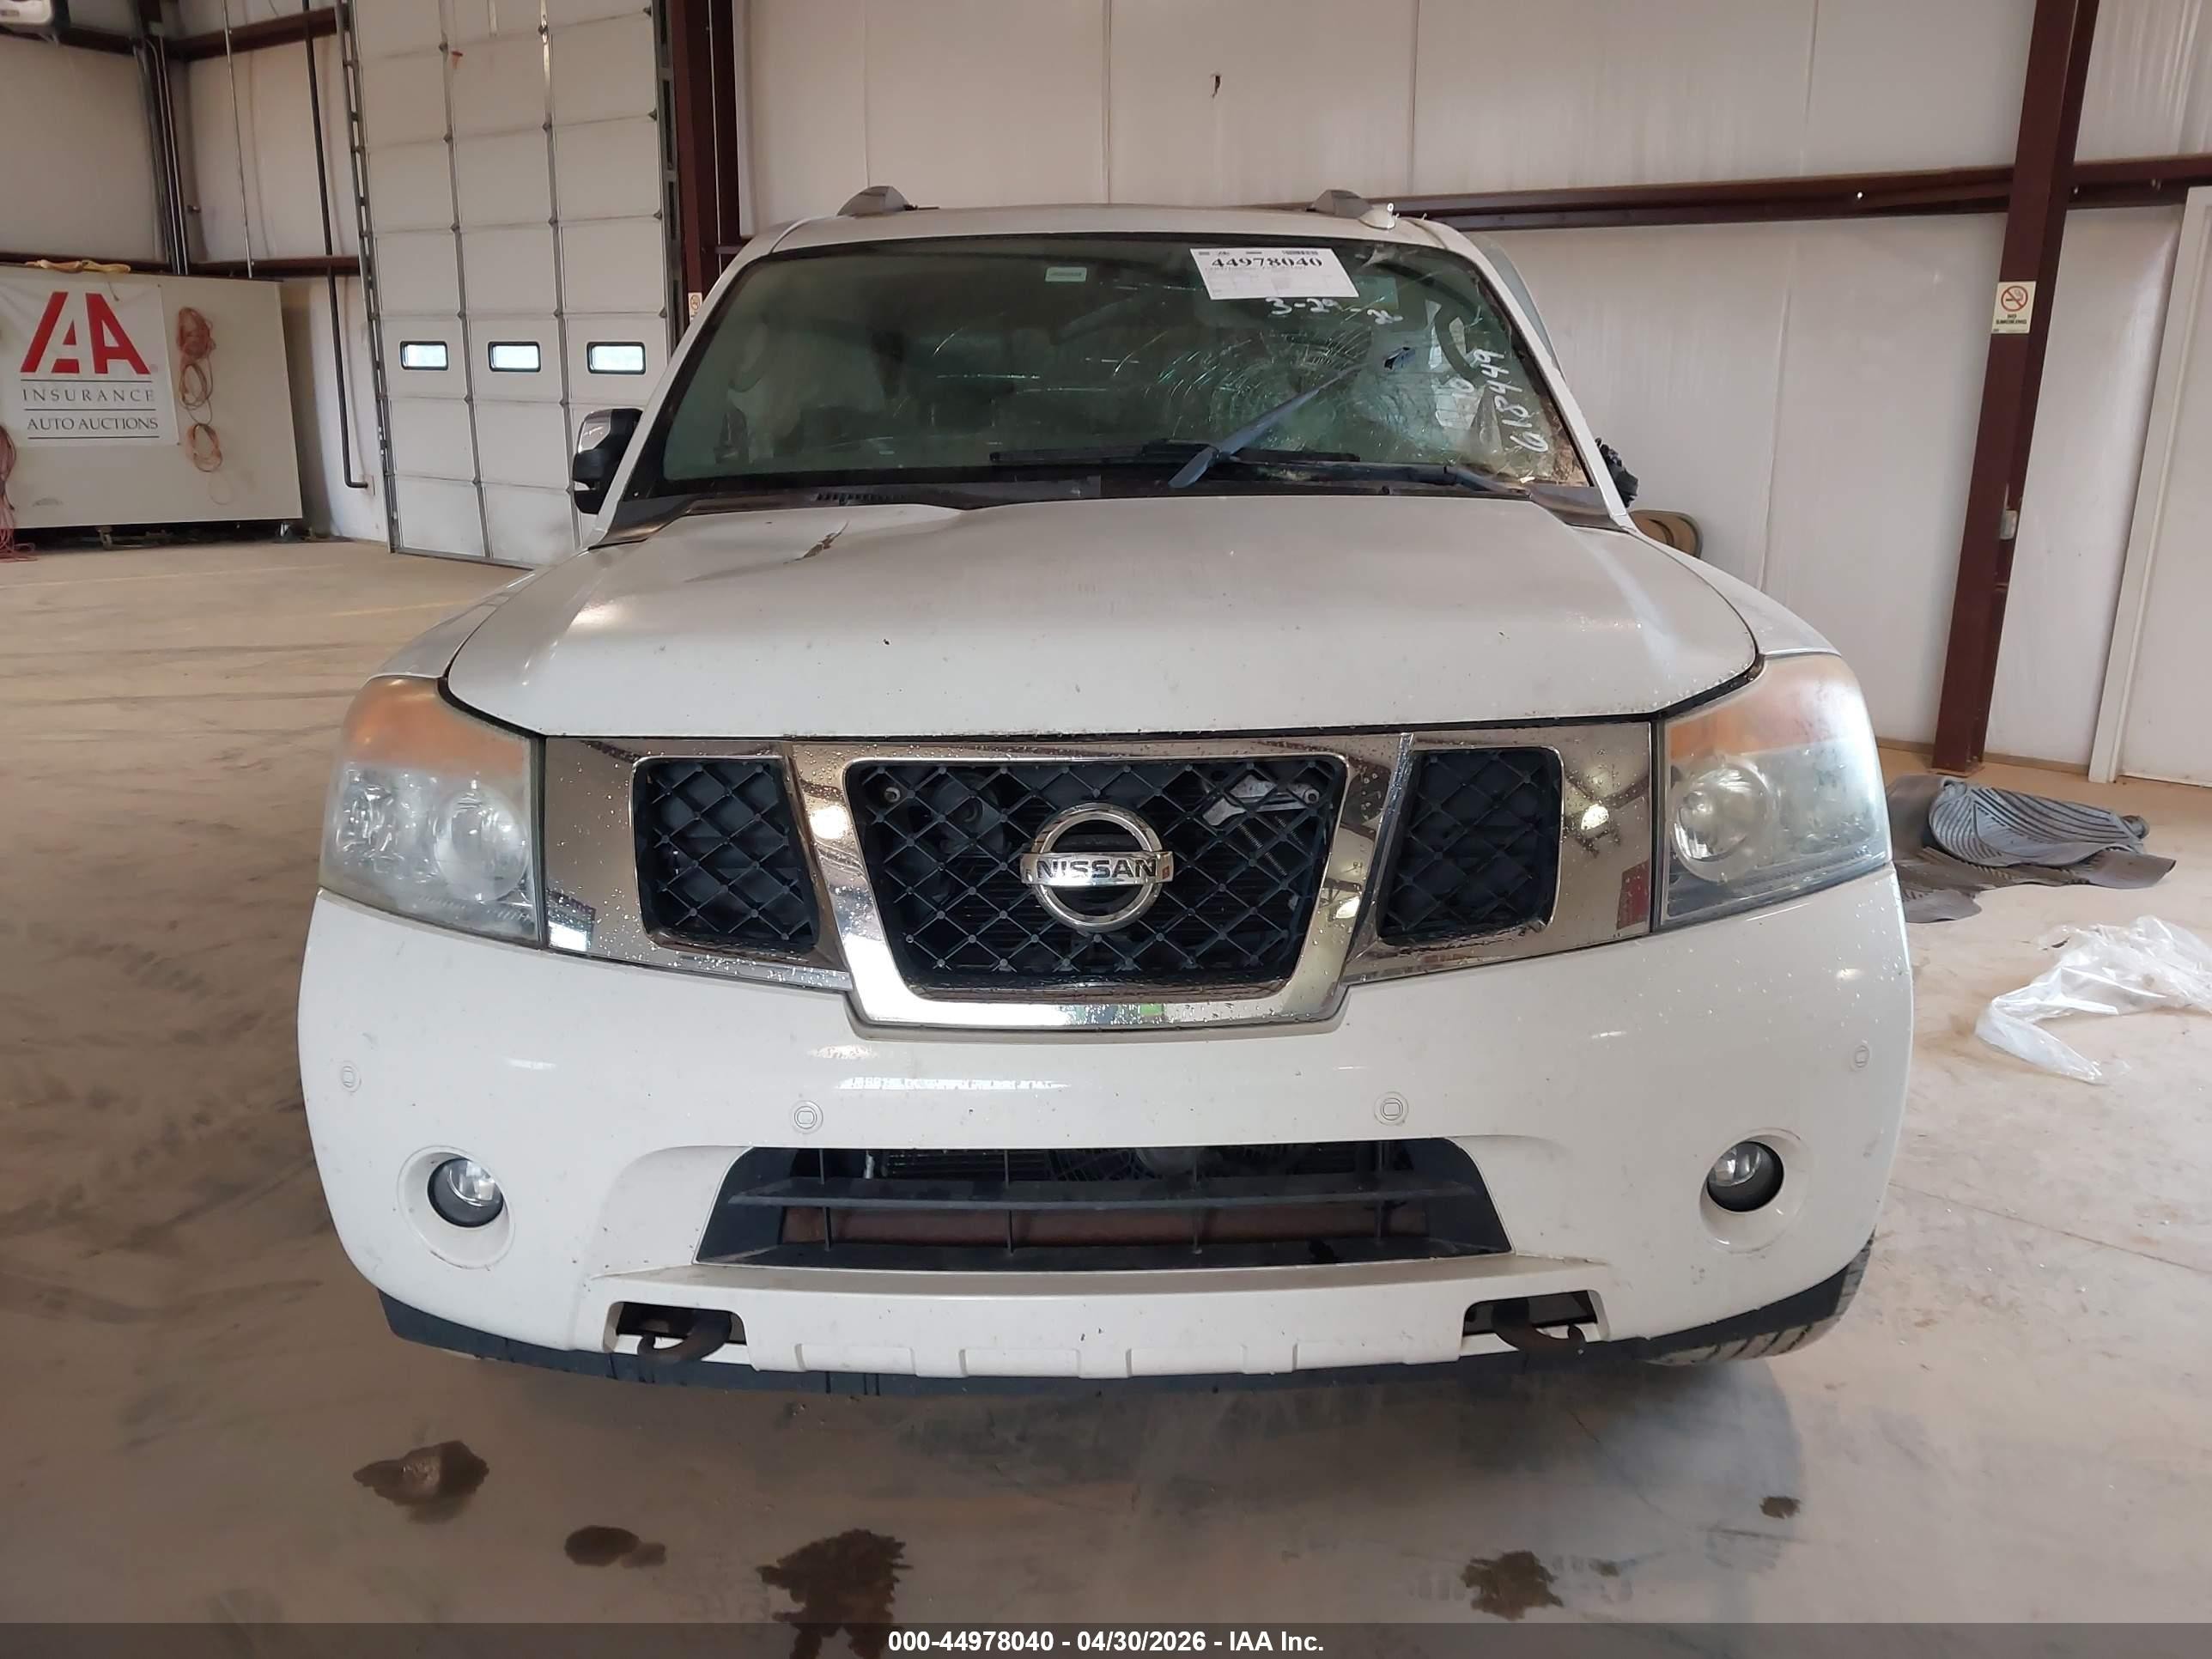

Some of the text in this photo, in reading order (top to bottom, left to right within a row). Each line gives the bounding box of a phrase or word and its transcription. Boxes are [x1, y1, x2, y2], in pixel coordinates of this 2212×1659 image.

[1212, 258, 1322, 267] 44978040
[22, 388, 155, 402] INSURANCE
[27, 417, 159, 430] AUTO AUCTIONS
[1036, 860, 1157, 879] NISSAN
